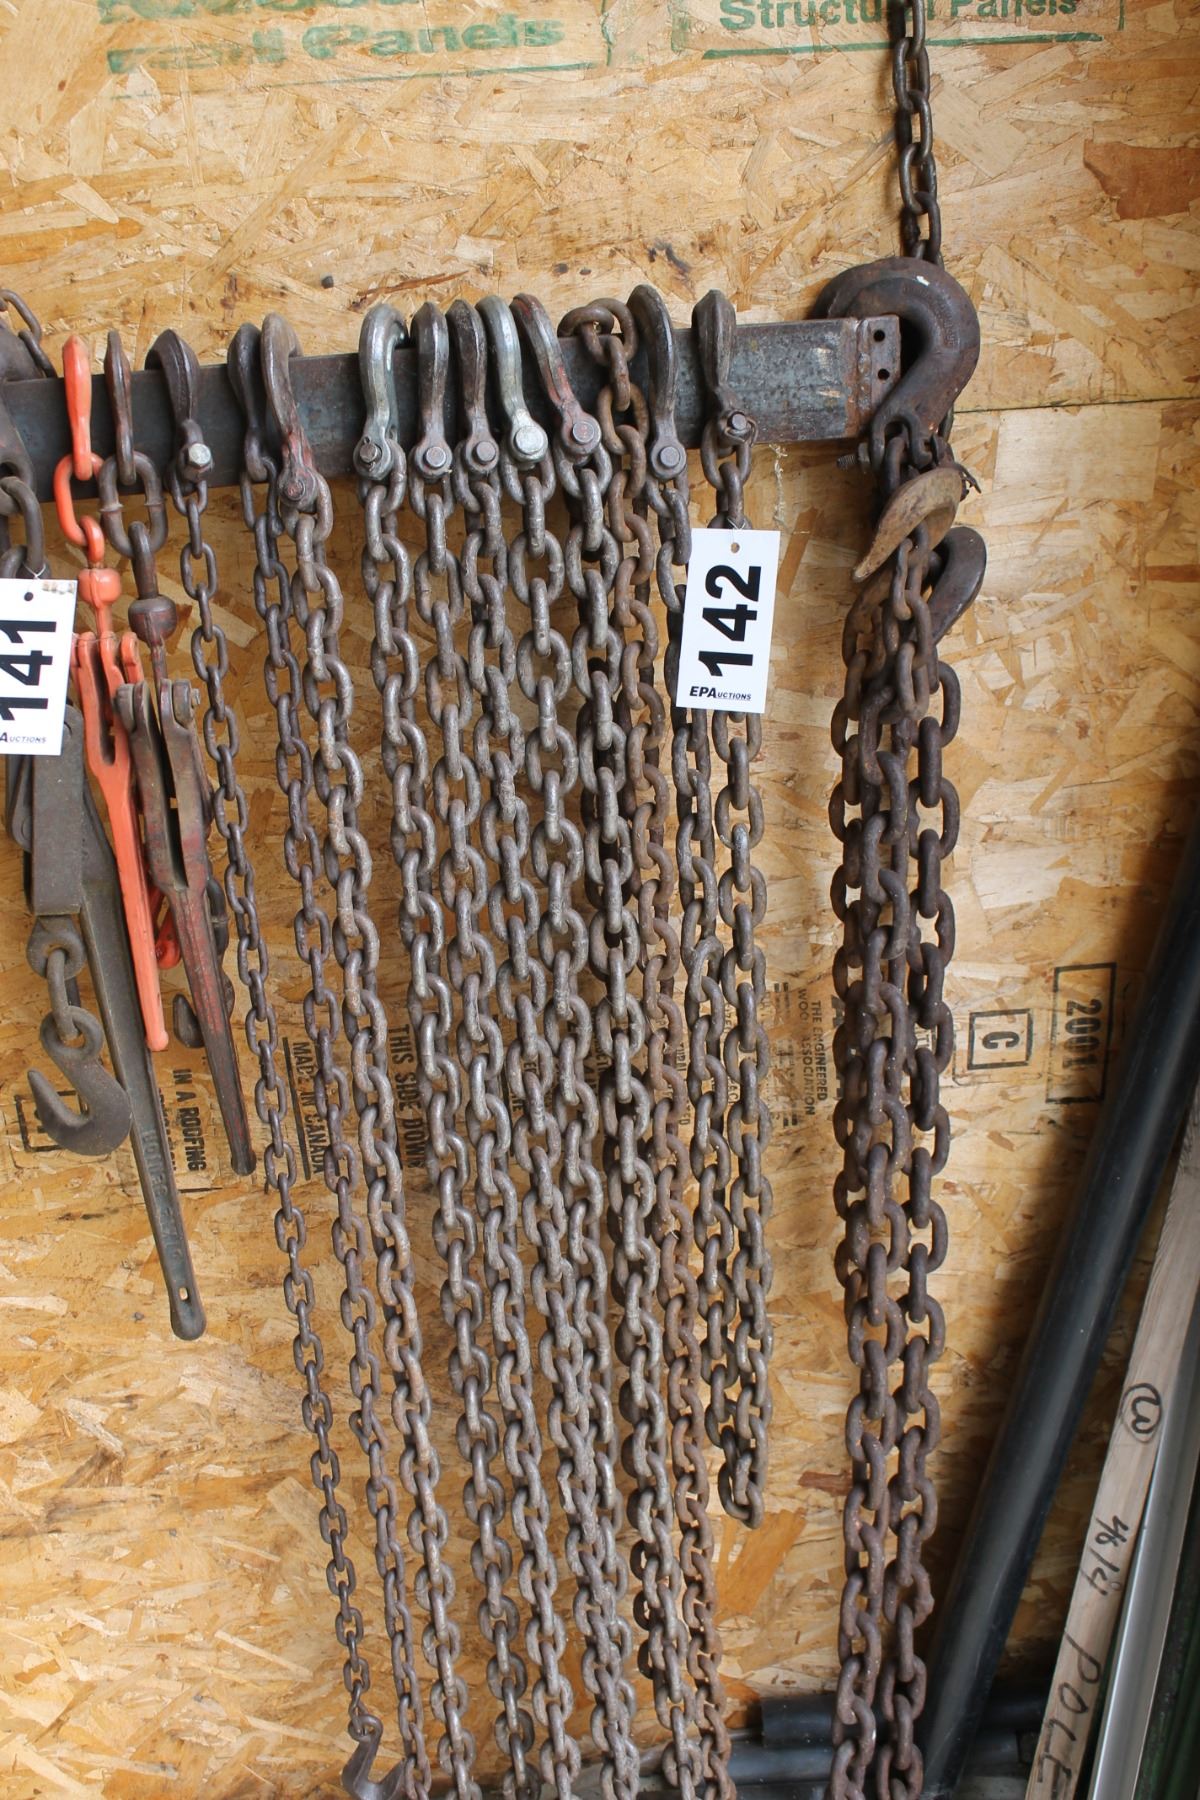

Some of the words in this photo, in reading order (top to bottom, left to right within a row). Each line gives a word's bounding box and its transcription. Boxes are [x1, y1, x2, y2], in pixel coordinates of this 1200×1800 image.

[302, 14, 566, 60] Panels
[720, 0, 935, 30] Structul
[698, 565, 762, 677] 142
[0, 620, 57, 720] 141
[798, 989, 808, 1031] WOO
[811, 1001, 822, 1023] THE
[389, 1024, 414, 1064] THIS
[982, 1032, 1020, 1050] C
[1063, 999, 1102, 1069] 2001
[173, 1069, 192, 1085] IN
[801, 1036, 815, 1115] ASSOCIATION
[814, 1027, 828, 1101] ENGINEERED
[176, 1091, 196, 1102] A
[300, 1091, 317, 1106] IN
[394, 1073, 422, 1112] SIDE
[179, 1107, 206, 1171] ROOFING
[304, 1114, 327, 1174] CANADA
[401, 1118, 425, 1169] DOWN
